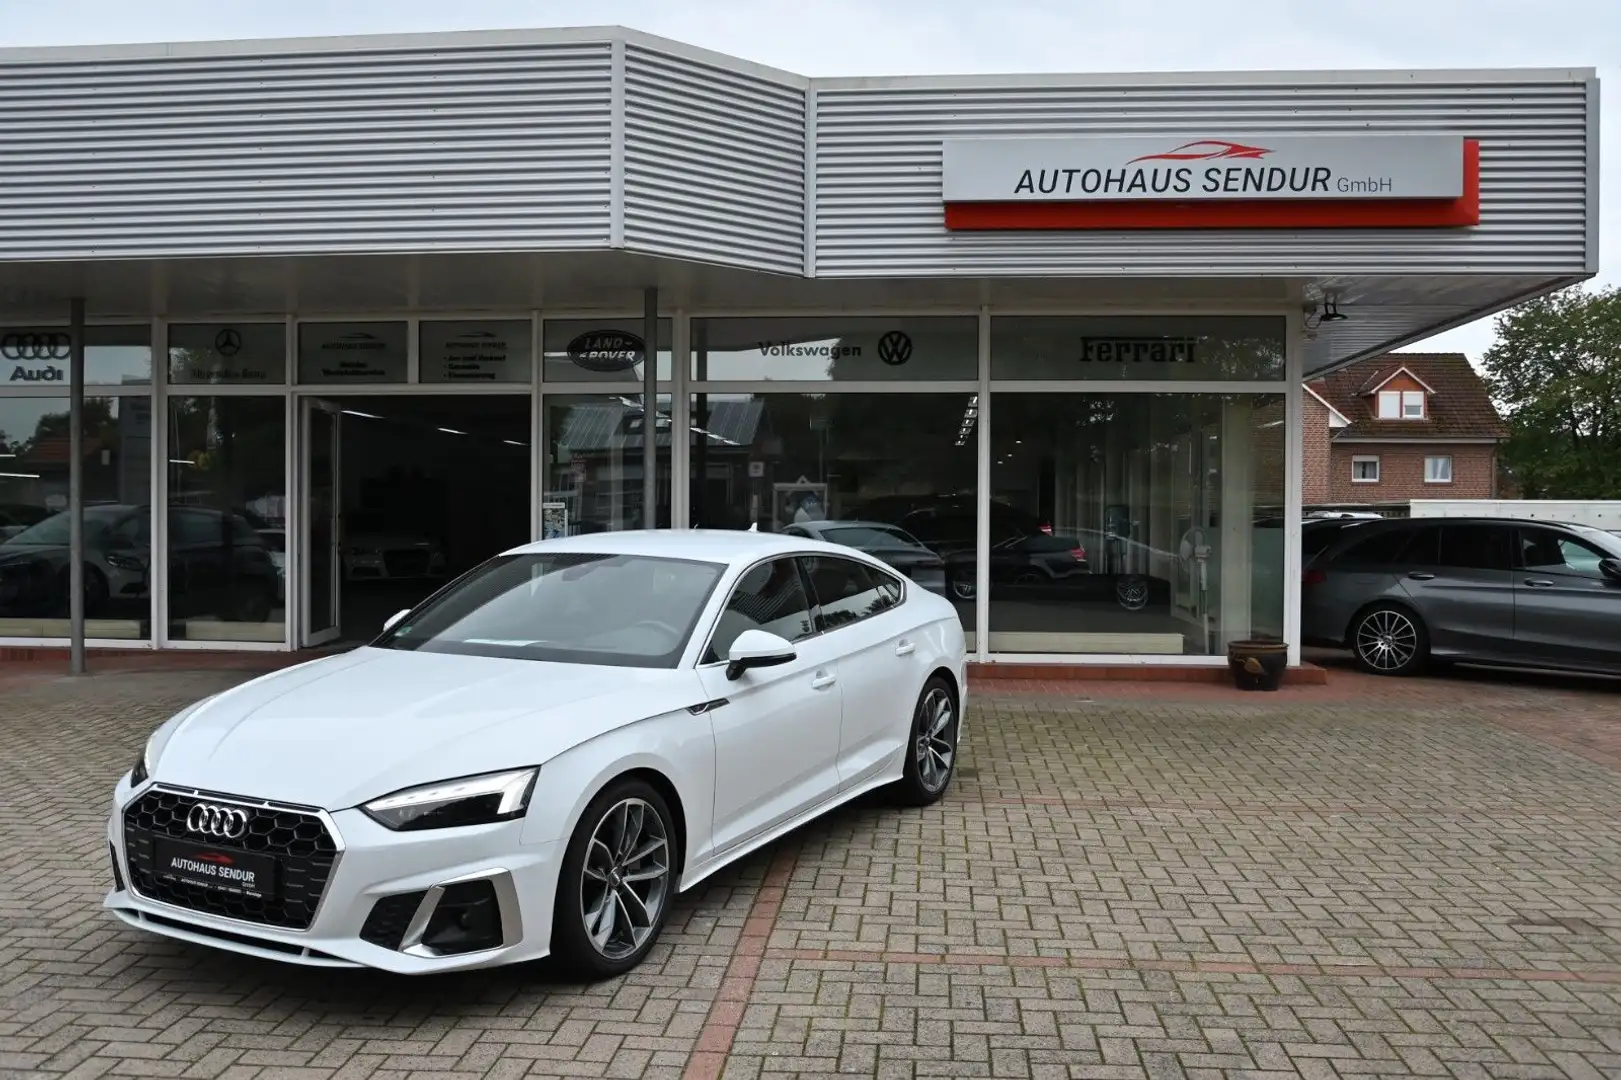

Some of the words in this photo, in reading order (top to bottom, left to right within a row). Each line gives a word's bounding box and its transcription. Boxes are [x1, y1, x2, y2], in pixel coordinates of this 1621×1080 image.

[1014, 168, 1193, 194] AUTOHAUS
[1201, 167, 1332, 193] SENDUR
[1337, 177, 1393, 193] GmbH
[757, 339, 862, 360] Volkswagen
[1079, 336, 1197, 363] Ferrari
[9, 365, 64, 381] Audi
[171, 857, 217, 876] AUTOHAUS
[218, 866, 256, 882] SENDUR
